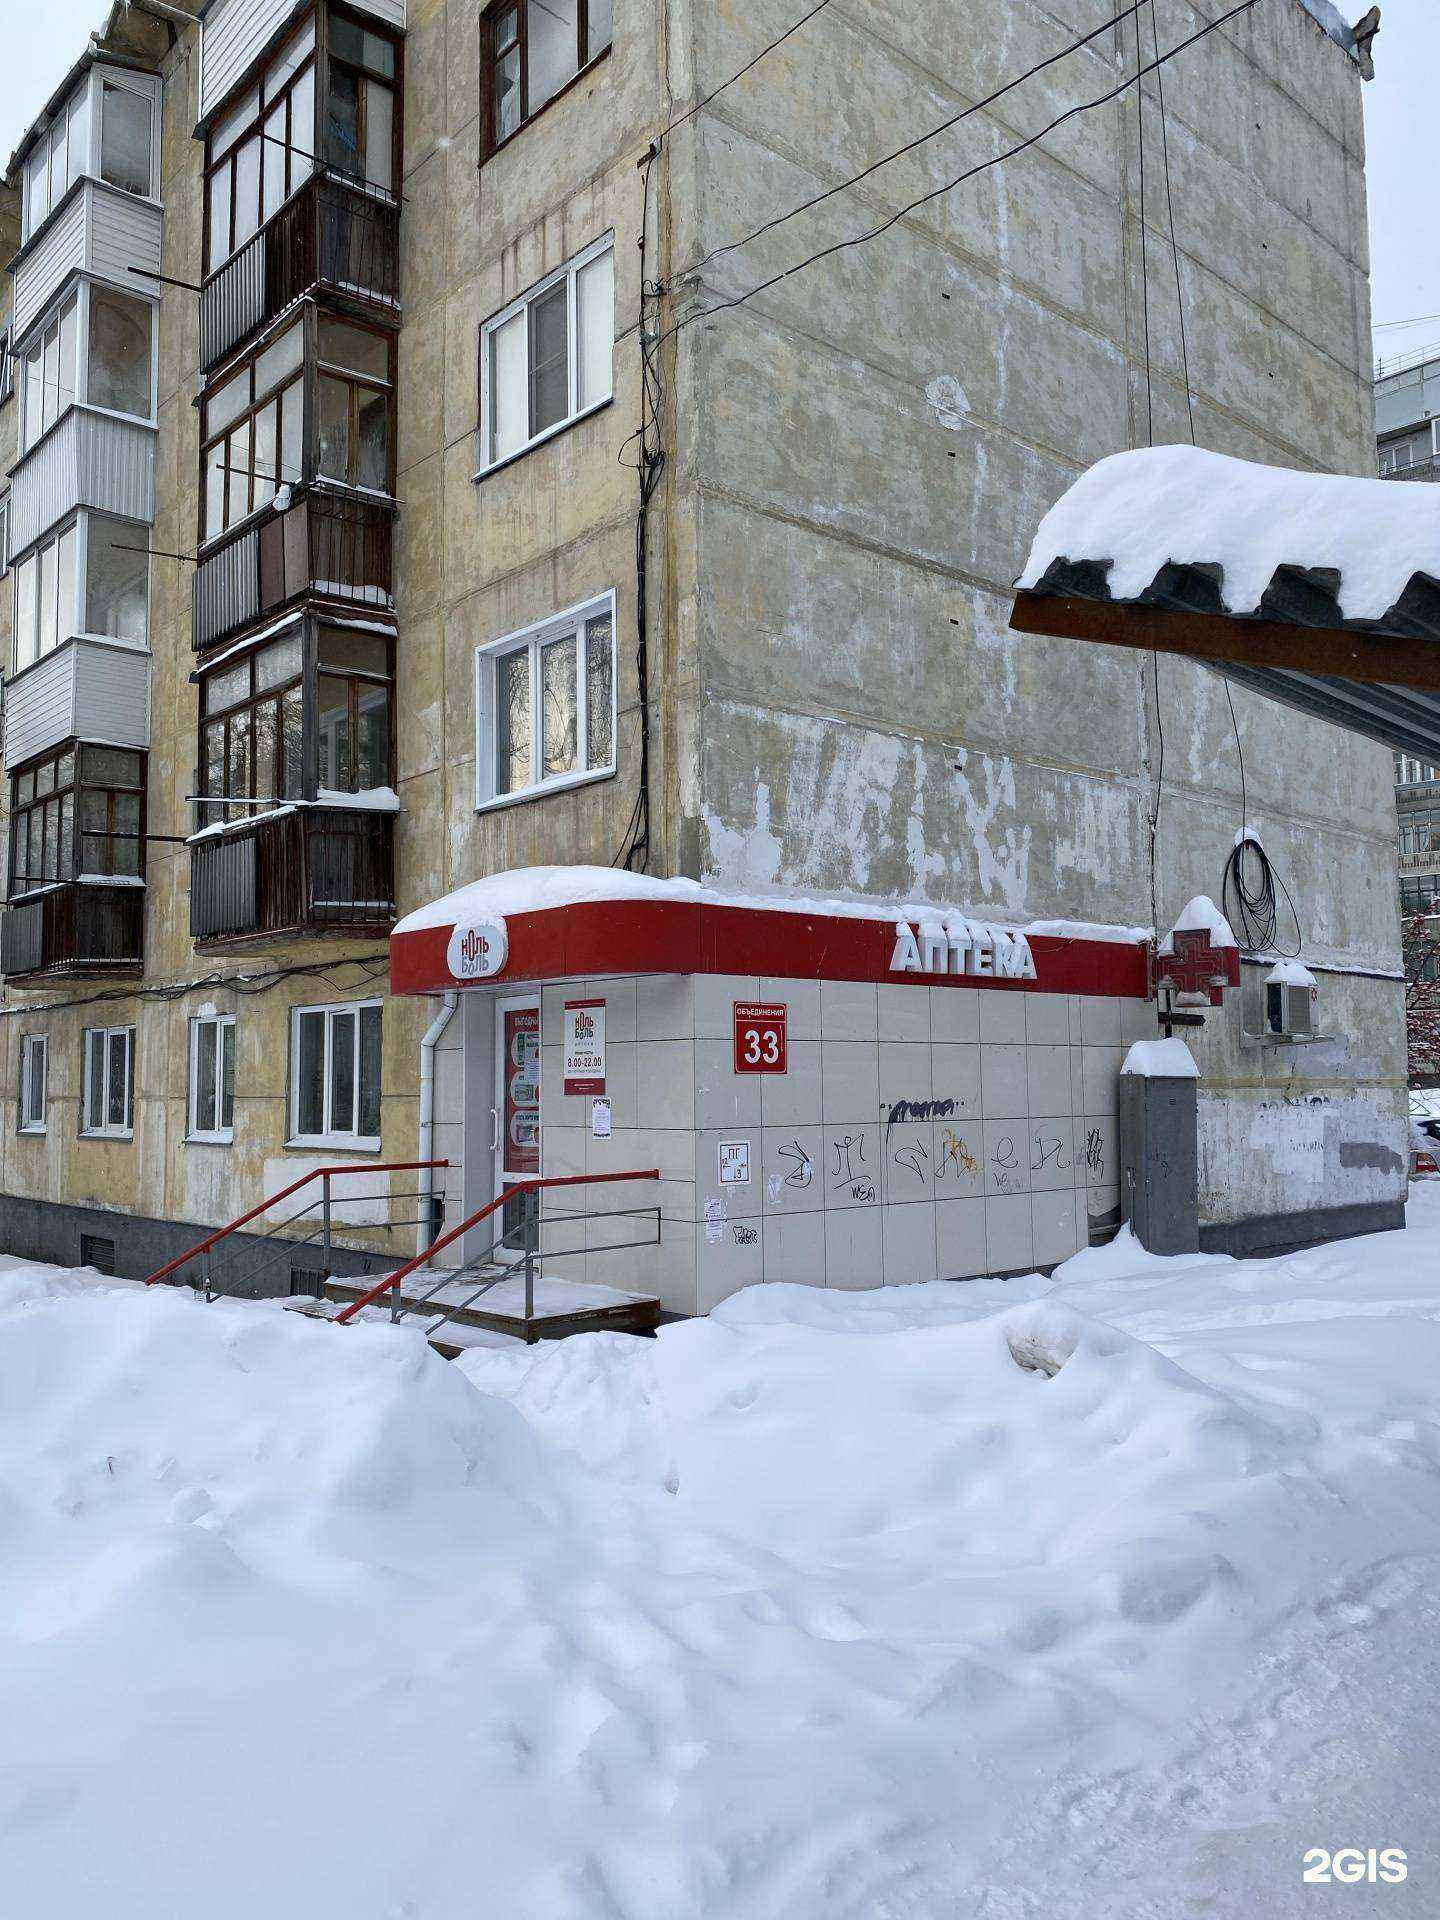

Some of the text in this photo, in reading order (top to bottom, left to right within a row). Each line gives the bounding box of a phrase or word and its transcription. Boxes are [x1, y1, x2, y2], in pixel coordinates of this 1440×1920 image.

[461, 930, 489, 961] НОЛЬ
[889, 933, 1038, 980] АПТЕКА
[461, 956, 489, 975] БОЛЬ
[736, 1008, 784, 1017] ОБЪЕДИНЕНИЯ
[744, 1030, 779, 1064] 33
[728, 1147, 741, 1160] ПГ
